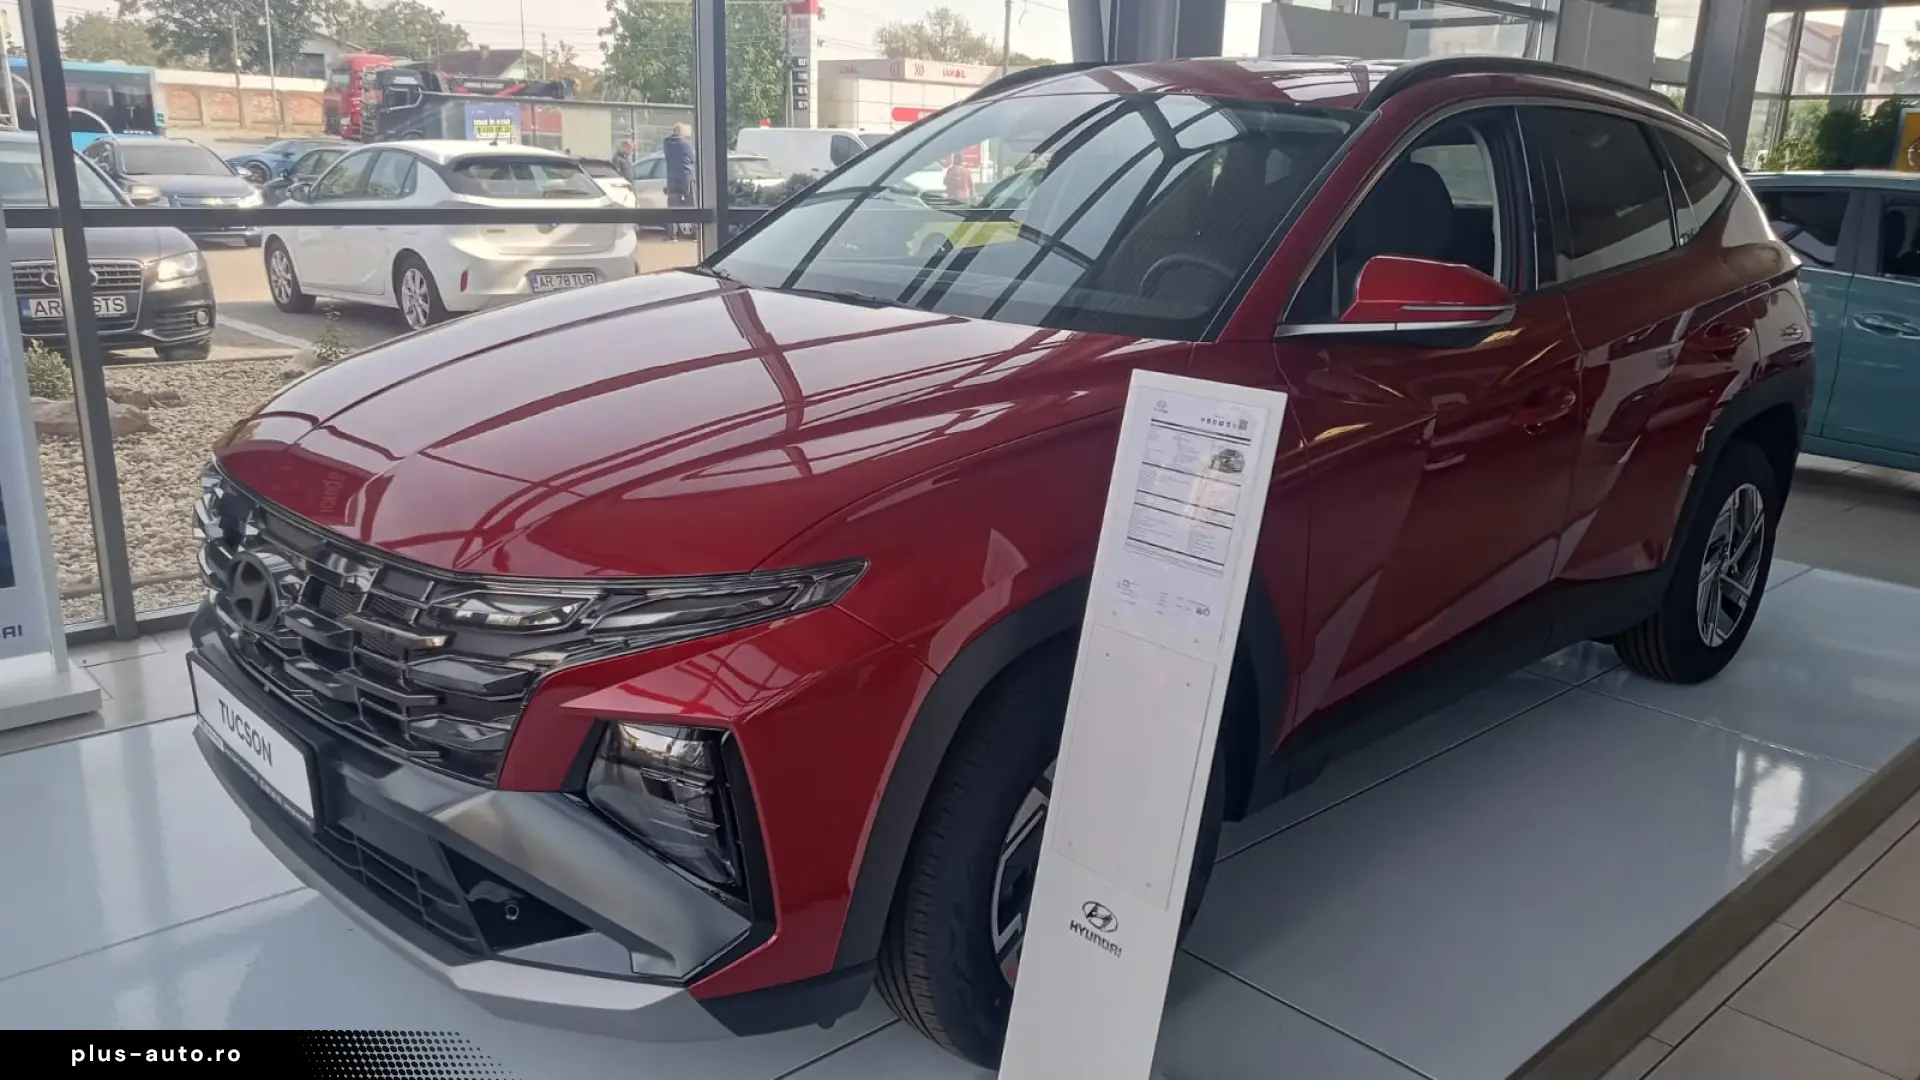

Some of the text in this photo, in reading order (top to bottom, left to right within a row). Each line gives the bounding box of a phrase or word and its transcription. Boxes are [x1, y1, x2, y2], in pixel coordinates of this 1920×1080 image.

[540, 275, 554, 288] AR
[34, 300, 62, 316] AR
[218, 698, 273, 768] TUCSON
[1069, 919, 1122, 958] HYUNDAI
